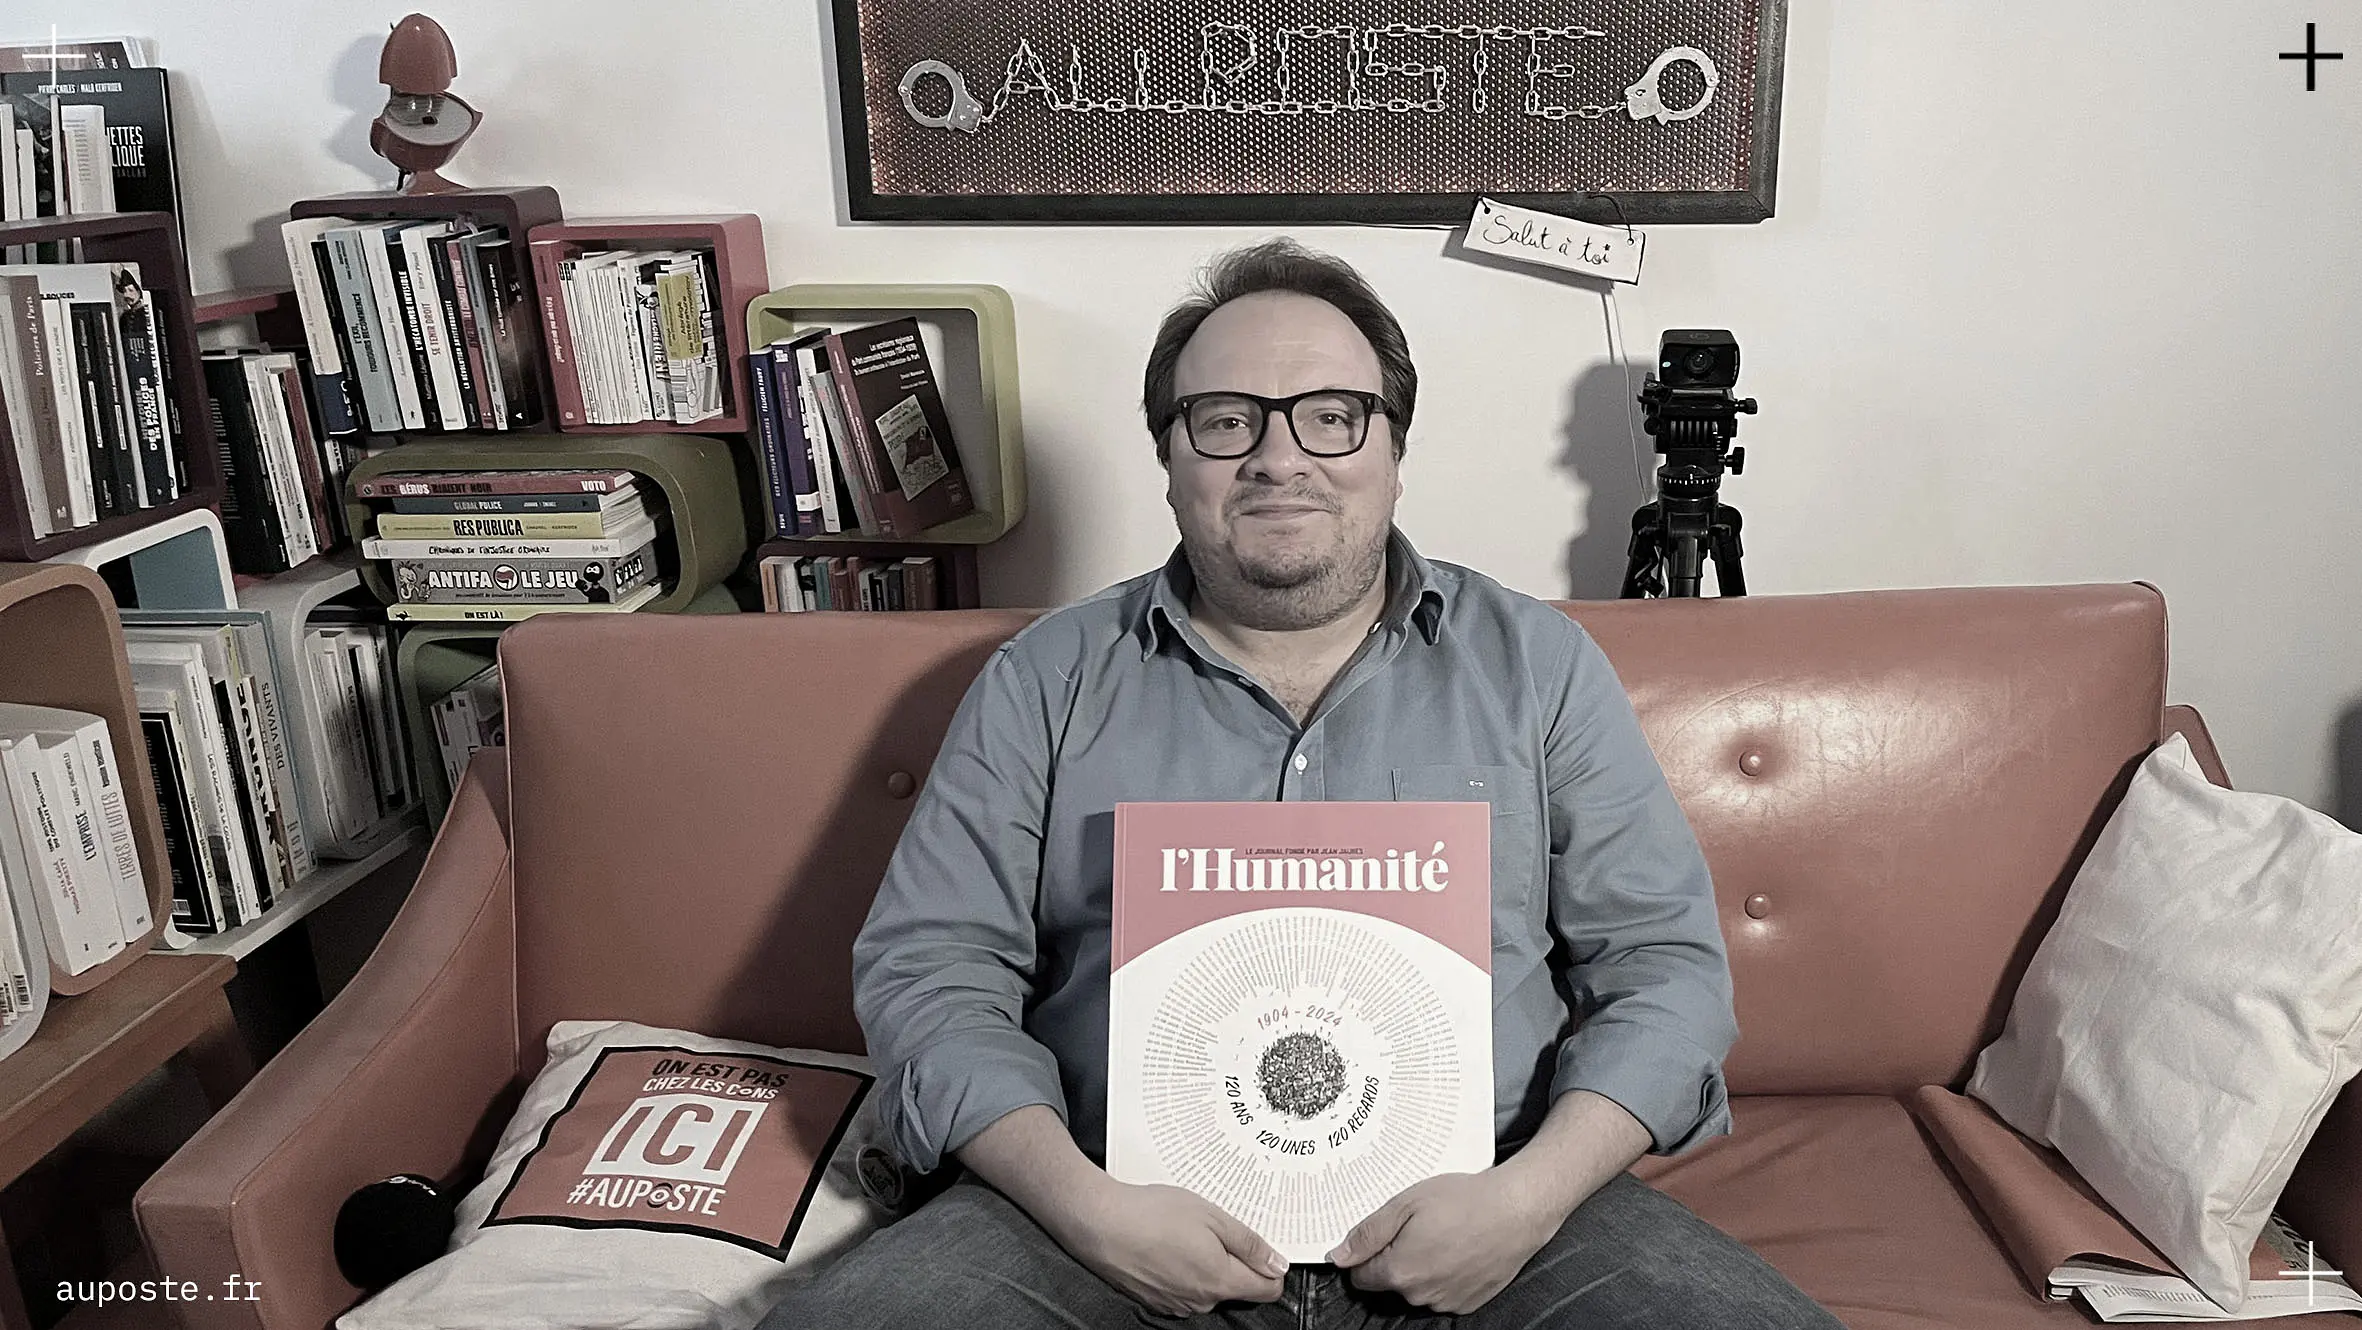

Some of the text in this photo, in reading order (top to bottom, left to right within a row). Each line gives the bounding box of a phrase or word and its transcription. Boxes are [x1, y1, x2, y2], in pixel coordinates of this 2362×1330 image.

[1200, 22, 1603, 117] POSTE
[110, 146, 146, 167] LIQUE
[1483, 215, 1612, 265] Salut à toi
[398, 270, 413, 304] INVISIBLE
[405, 304, 423, 351] L'HÉCATOMBE
[421, 301, 434, 325] DROIT
[24, 295, 44, 376] Policiers de Paris
[426, 324, 438, 346] TENIR
[431, 347, 440, 356] SE
[138, 376, 154, 427] POLICES
[147, 387, 159, 424] FRANCE
[147, 428, 158, 451] DES
[154, 426, 161, 439] EN
[399, 482, 430, 495] BÉRUS
[581, 480, 607, 491] VOTO
[453, 501, 503, 510] GLOBAL POLICE
[453, 519, 475, 537] RES
[477, 519, 524, 537] PUBLICA
[427, 570, 579, 590] ANTIFA LE JEU
[464, 611, 475, 619] ON
[476, 611, 490, 619] EST
[260, 681, 285, 769] DES VIVANTS
[31, 770, 47, 808] POLITIQUE
[71, 786, 81, 806] MARC
[100, 790, 124, 828] LUTTES
[74, 809, 97, 860] L'EMPRISE
[110, 828, 128, 842] DE
[113, 842, 137, 880] TERRES
[1159, 840, 1450, 893] l'Humanité
[1245, 848, 1253, 856] LE
[1254, 848, 1284, 856] JOURNAL
[1307, 848, 1320, 856] PAR
[1320, 848, 1337, 856] JEAN
[68, 885, 81, 914] THOMAS
[1257, 1004, 1289, 1031] 1904
[1305, 1004, 1343, 1027] 2024
[651, 1058, 790, 1088] ON EST PAS
[642, 1077, 779, 1100] CHEZ LES CONS
[1224, 1074, 1380, 1155] 120 ANS 120 UNES 120 REGARDS
[601, 1102, 754, 1171] ICI
[565, 1177, 727, 1216] #AUPOSTE
